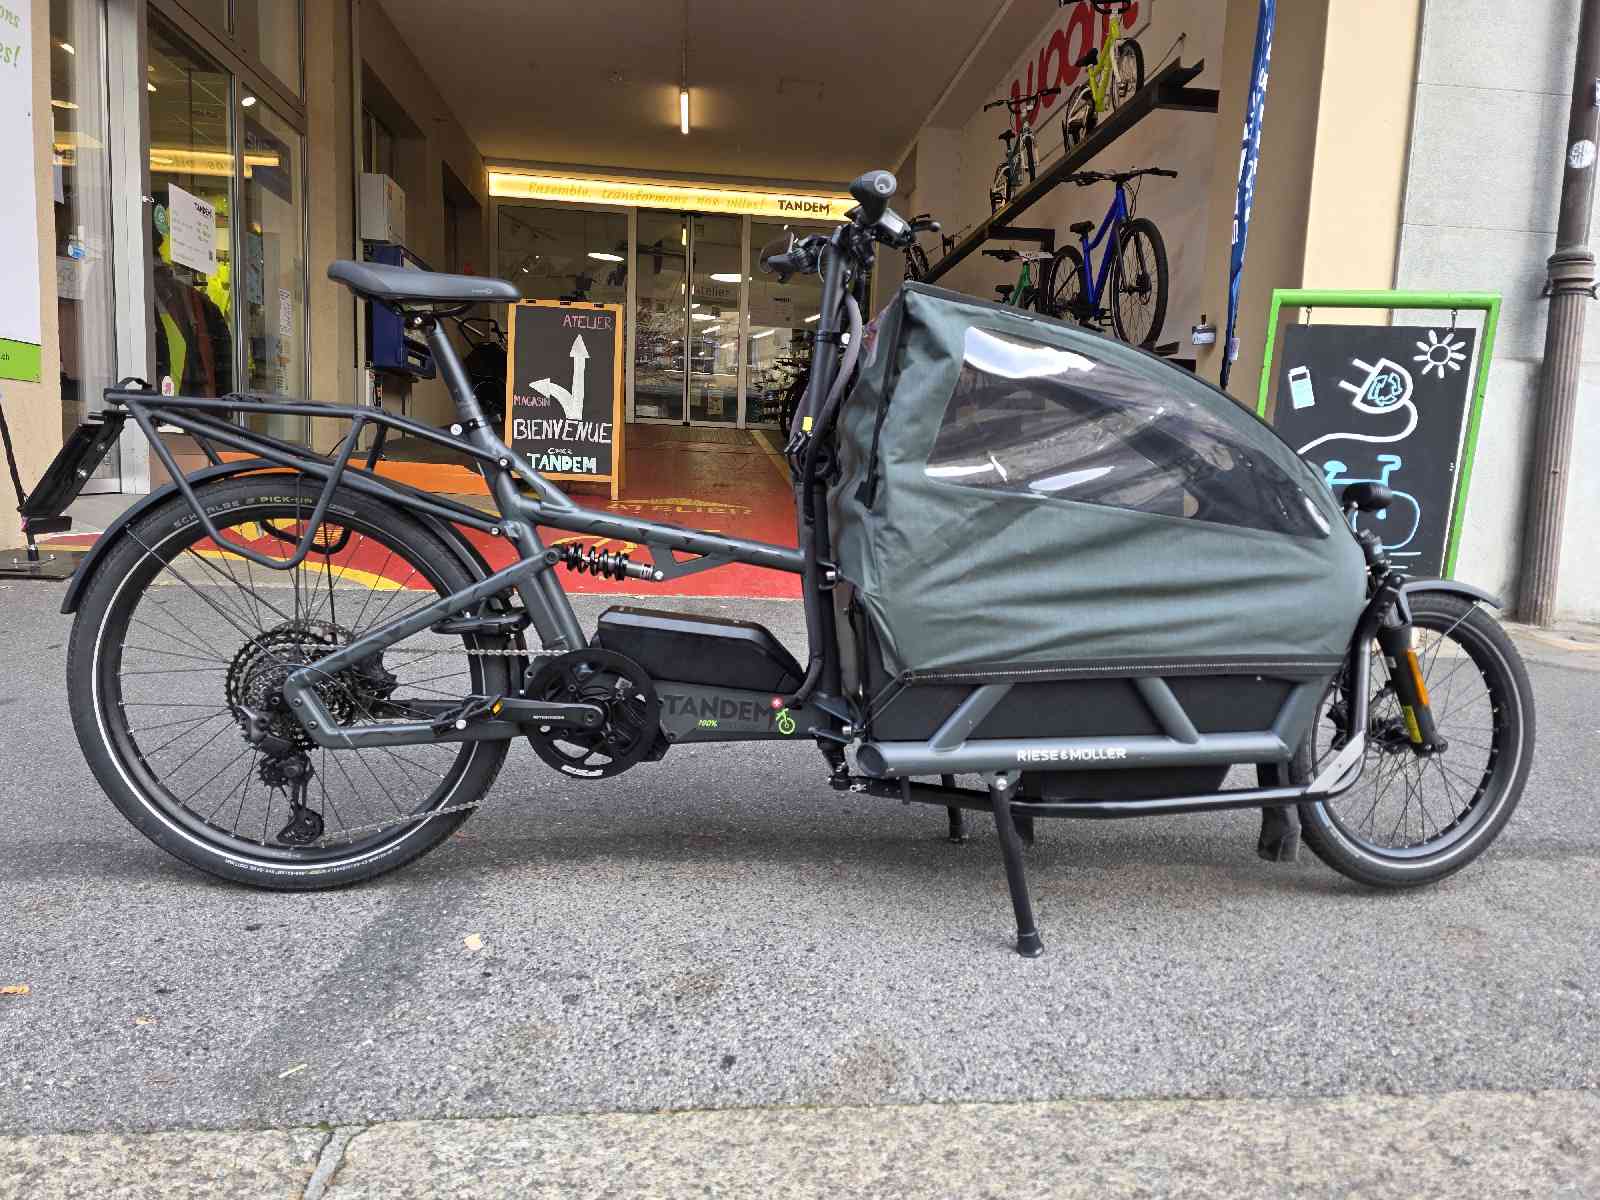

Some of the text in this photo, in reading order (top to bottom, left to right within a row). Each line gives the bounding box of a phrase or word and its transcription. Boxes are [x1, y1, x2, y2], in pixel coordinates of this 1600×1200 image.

[777, 199, 830, 215] TANDEM
[563, 314, 613, 330] ATELIER
[513, 395, 551, 407] MAGASIN
[513, 418, 613, 444] BIENVENUE
[526, 452, 597, 474] TANDEM
[173, 500, 241, 528] SCHALBE
[663, 694, 772, 723] TANDEM
